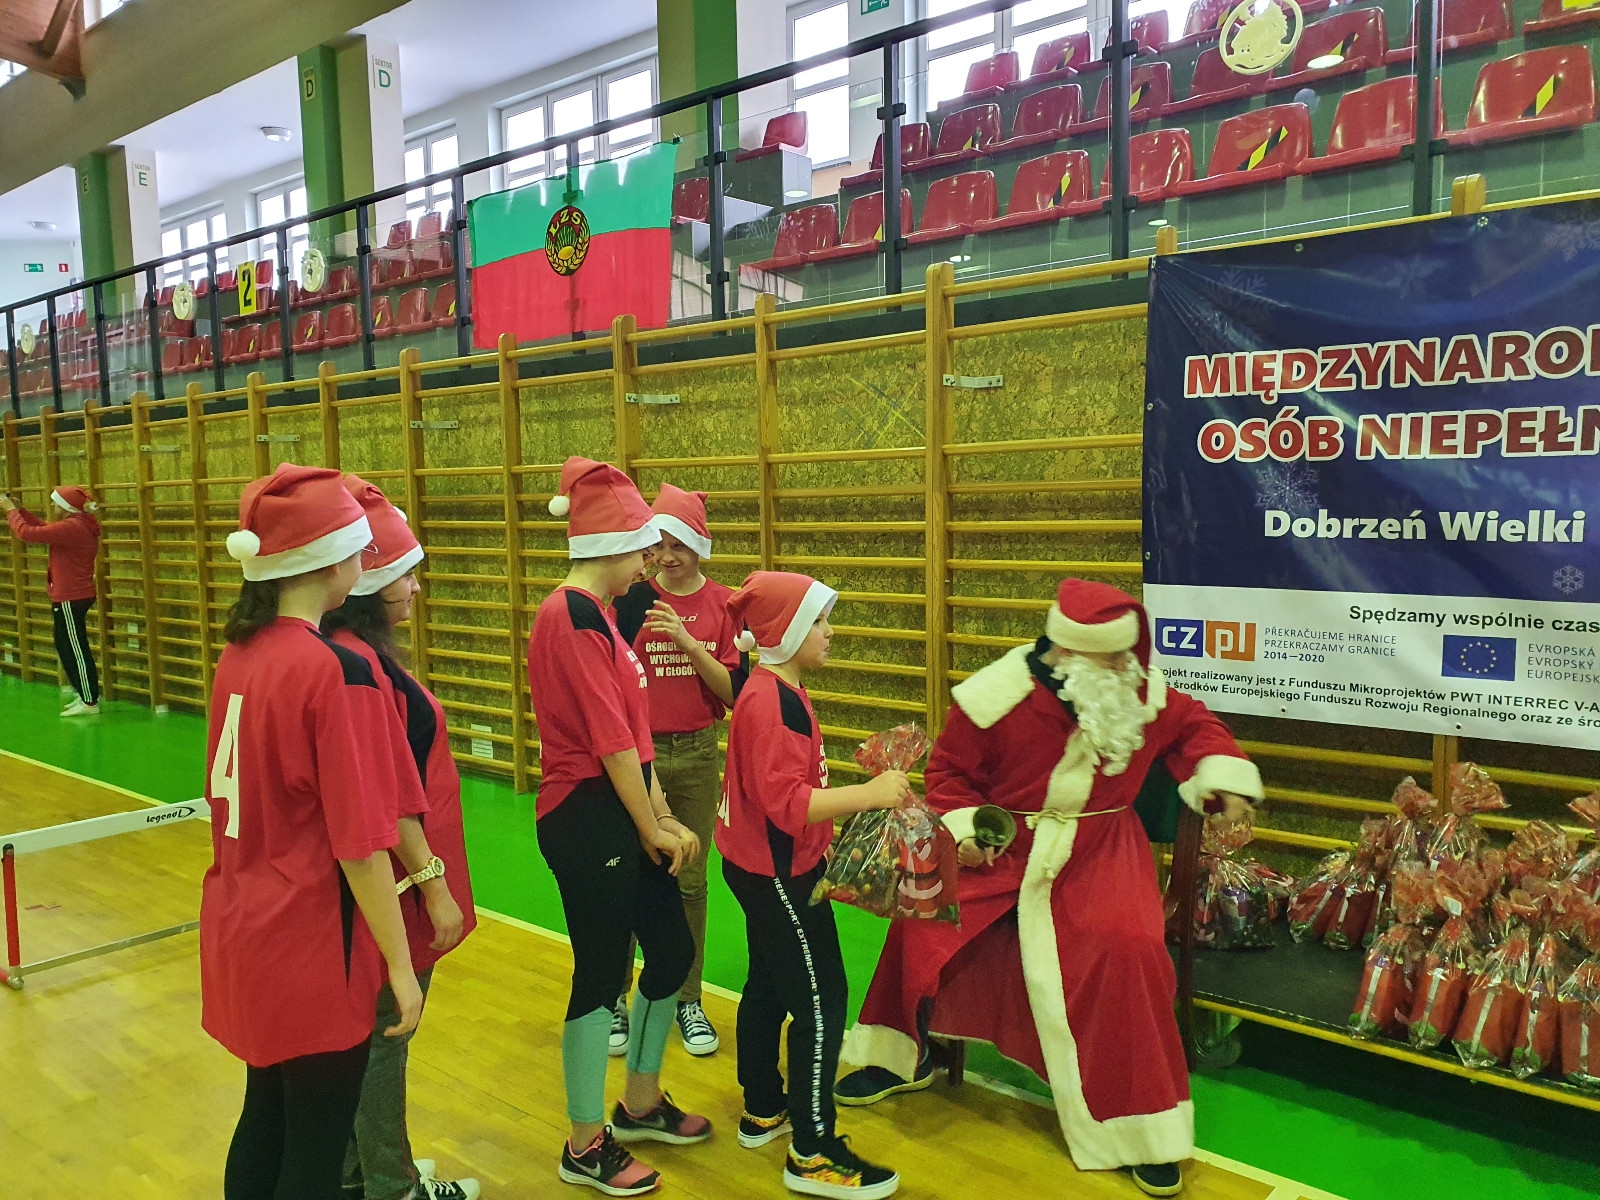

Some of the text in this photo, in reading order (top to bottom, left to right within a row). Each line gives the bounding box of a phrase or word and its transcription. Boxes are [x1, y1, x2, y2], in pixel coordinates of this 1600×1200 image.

[378, 69, 391, 88] D
[306, 80, 314, 98] D
[138, 172, 148, 187] E
[242, 268, 252, 307] 2
[1184, 324, 1600, 404] MIĘDZYNARO
[1198, 406, 1344, 463] OSÓB
[1264, 508, 1586, 543] Dobrzeń Wielki
[1349, 605, 1600, 633] Spędzamy wspólnie czas
[1264, 626, 1397, 645] PŘEKRAČUJEME HRANICE
[1264, 639, 1397, 657] PRZEKRACZAMY GRANICE
[1528, 643, 1596, 658] EVROPSKÁ
[649, 654, 692, 665] WYCHOW
[1527, 656, 1594, 670] EVROPSKÝ
[655, 667, 664, 677] W
[1527, 669, 1600, 684] EUROPEJSK
[1161, 667, 1600, 713] ojekt realizowany jest z Funduszu Mikroprojektów PWT INTERREC V-A
[1173, 680, 1219, 693] środków
[1221, 684, 1300, 702] Europejskiego
[1304, 691, 1362, 706] Funduszu
[1365, 697, 1419, 714] Rozwoju
[1422, 704, 1517, 722] Regionalnego
[1521, 713, 1553, 724] oraz
[1556, 716, 1573, 726] ze
[211, 692, 243, 839] 4
[773, 876, 801, 926] REMESPORT
[796, 928, 818, 992] EXTREMESPOR
